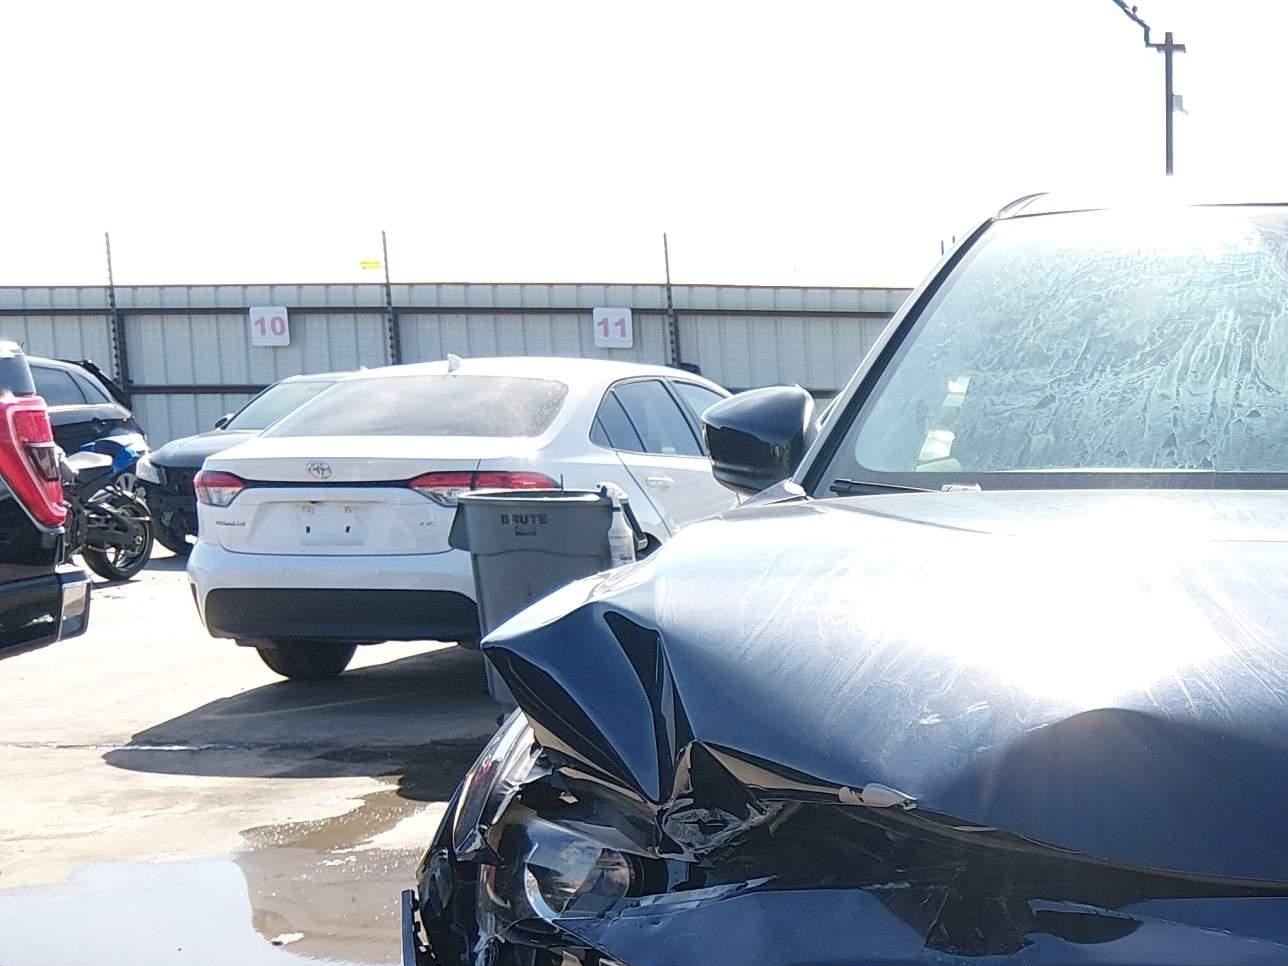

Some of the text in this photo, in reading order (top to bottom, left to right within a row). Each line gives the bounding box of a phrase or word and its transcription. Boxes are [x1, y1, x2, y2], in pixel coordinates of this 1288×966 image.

[254, 316, 287, 337] 10
[597, 317, 627, 338] 11
[500, 513, 549, 525] BRUTE
